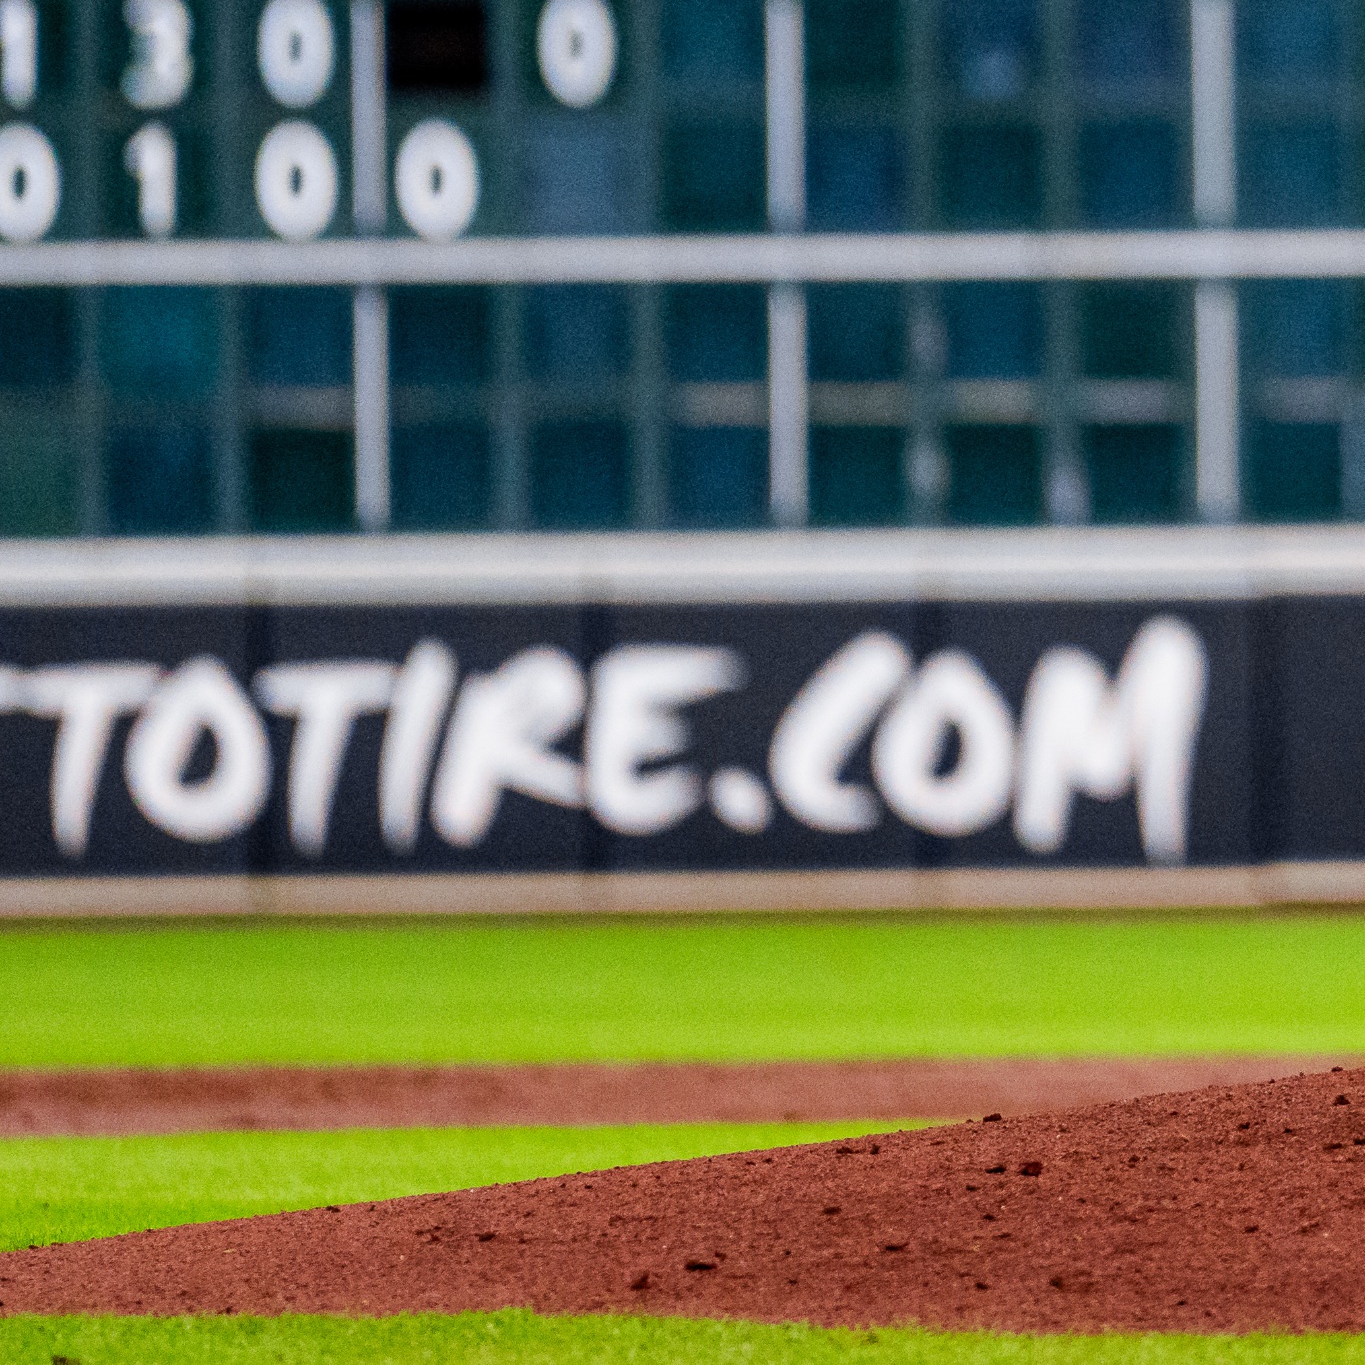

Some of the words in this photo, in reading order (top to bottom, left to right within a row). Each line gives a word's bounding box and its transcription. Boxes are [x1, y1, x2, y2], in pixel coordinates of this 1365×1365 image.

[124, 121, 177, 238] 1
[254, 118, 338, 243] 0
[397, 117, 480, 241] 0
